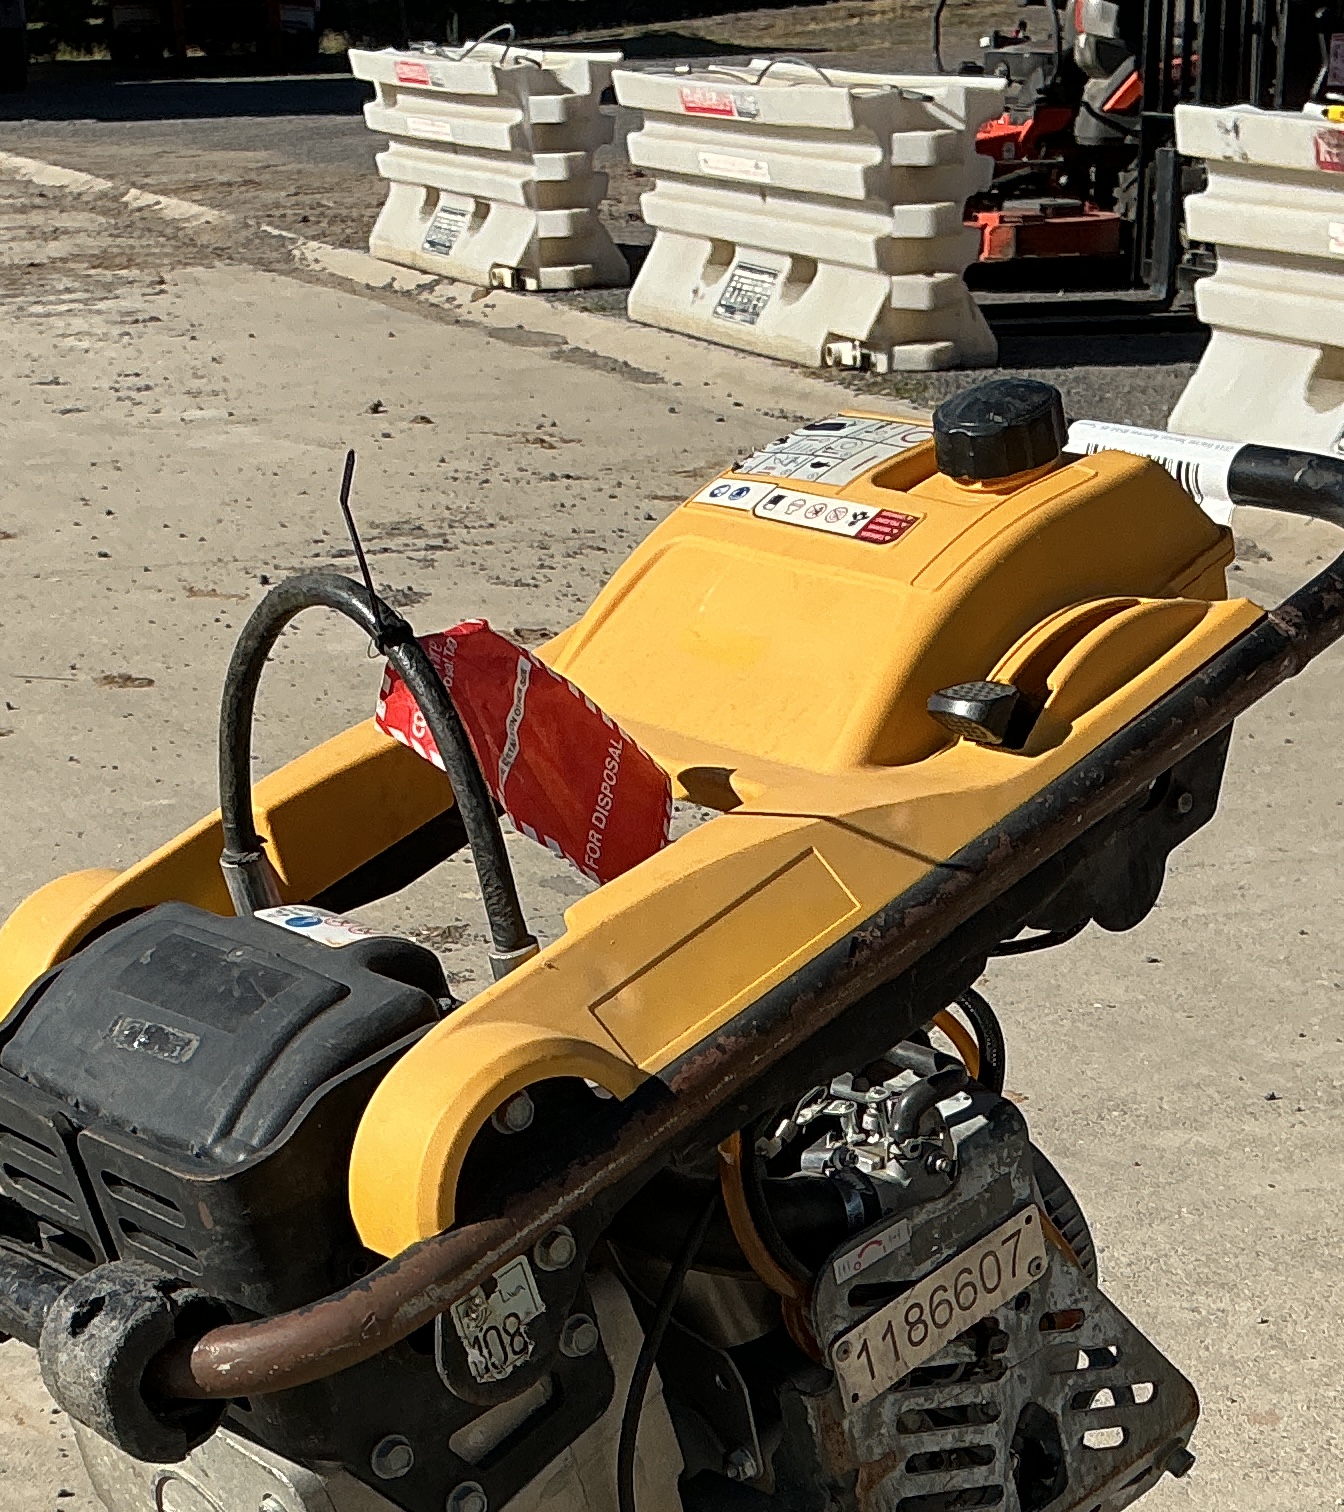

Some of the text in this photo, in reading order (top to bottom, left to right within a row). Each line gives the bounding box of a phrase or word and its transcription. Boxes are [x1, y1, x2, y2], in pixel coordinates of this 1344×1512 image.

[584, 738, 623, 870] FOR DISPOSAL
[856, 1228, 1023, 1381] 1186607
